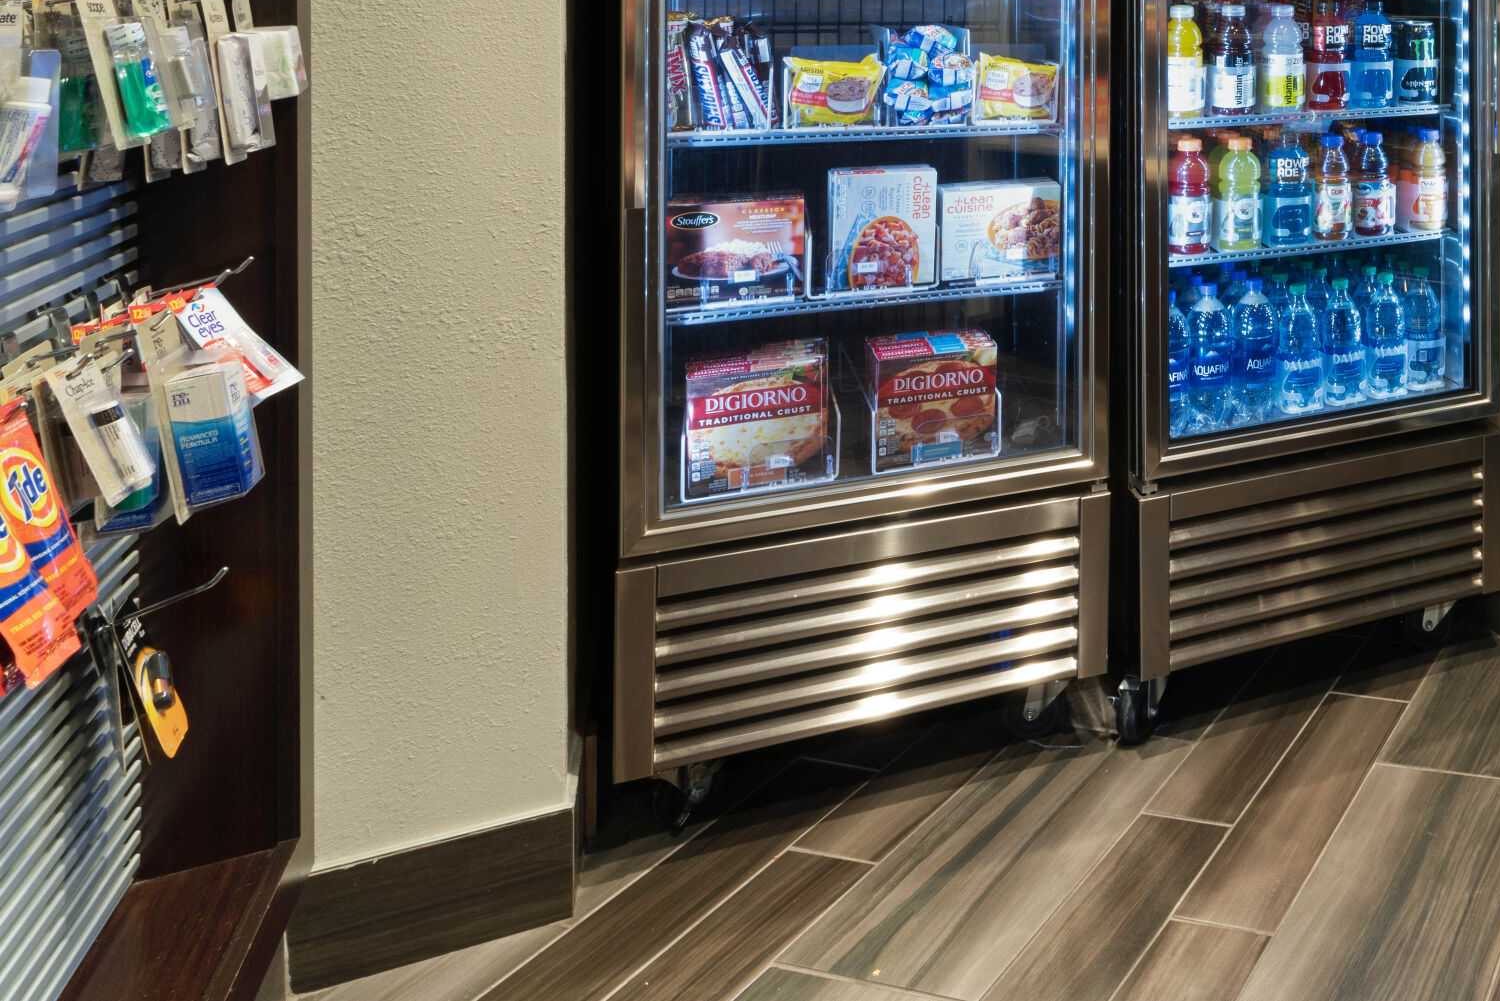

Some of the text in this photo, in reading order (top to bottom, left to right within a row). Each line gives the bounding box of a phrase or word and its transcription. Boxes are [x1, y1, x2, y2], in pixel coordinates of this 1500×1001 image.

[667, 45, 687, 94] TWIX
[1277, 167, 1300, 177] ADE
[676, 213, 714, 227] Stouffer's
[187, 307, 217, 330] Clear
[197, 320, 225, 340] eyes
[888, 386, 988, 405] TRADITIONAL CRUST
[699, 405, 812, 427] TRADITIONAL CRUST
[180, 429, 218, 443] ADVANCED
[180, 437, 218, 450] FORMULA
[8, 462, 48, 525] Tide
